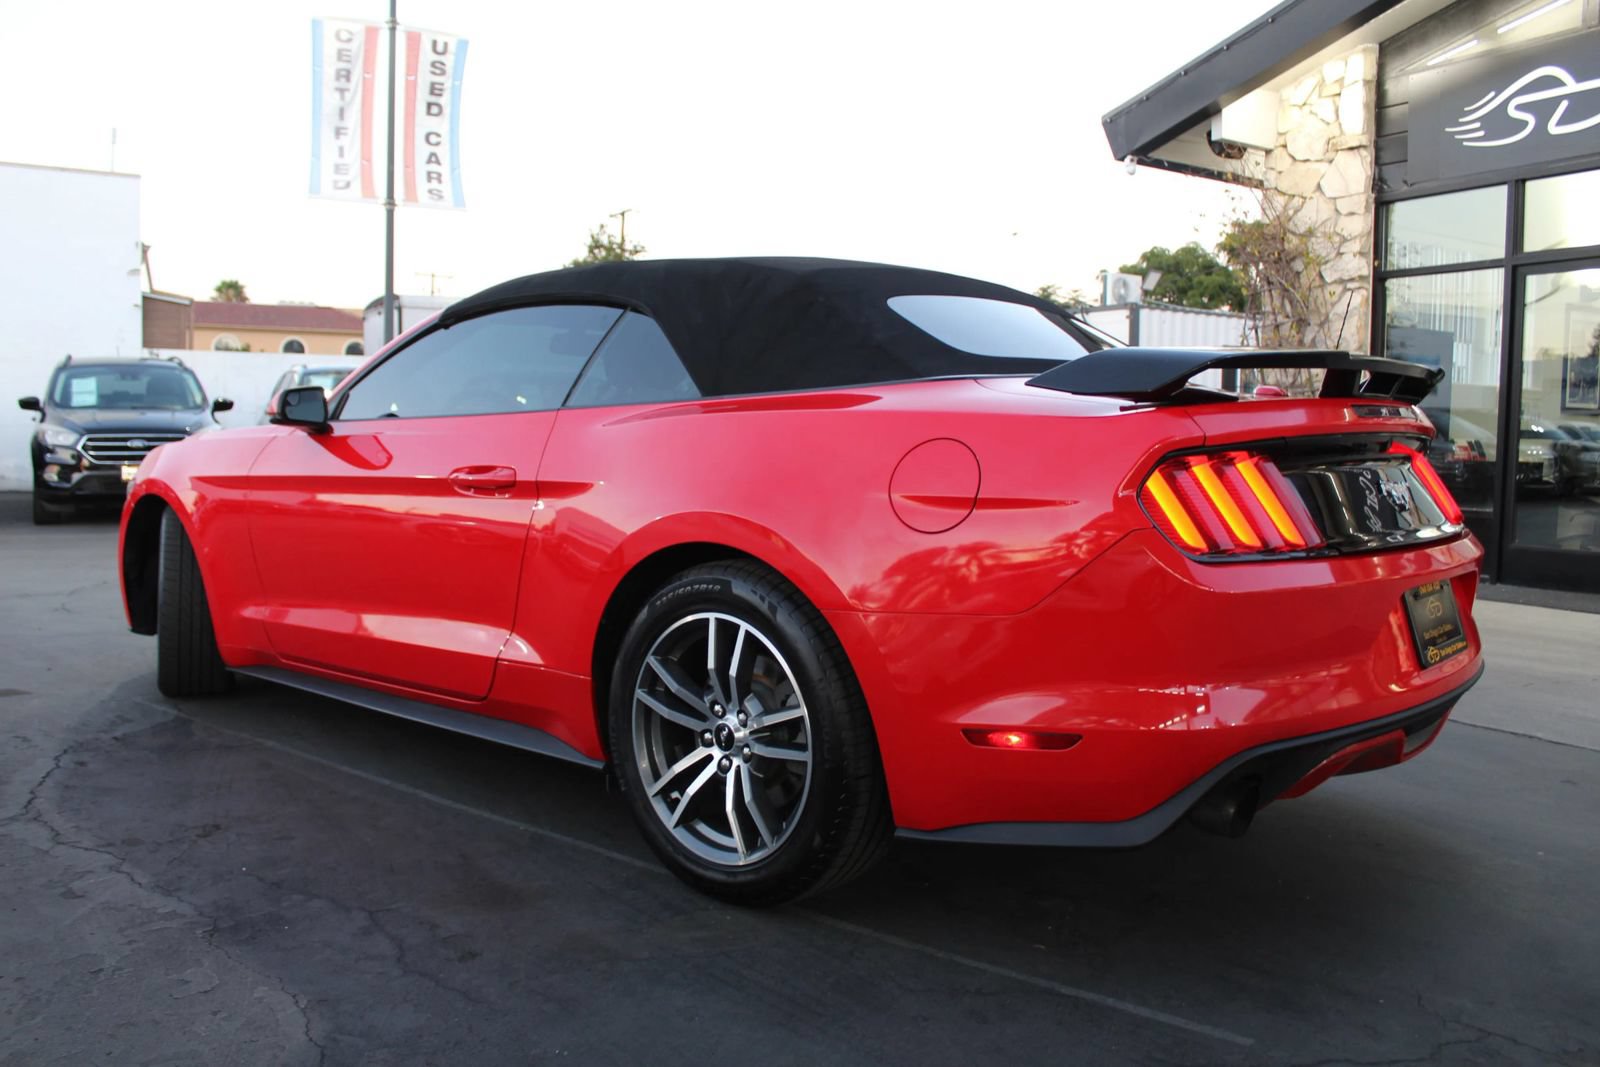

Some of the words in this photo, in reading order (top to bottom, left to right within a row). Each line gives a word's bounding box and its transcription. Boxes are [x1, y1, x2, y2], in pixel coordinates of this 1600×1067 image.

[332, 28, 354, 191] CERTIFIED
[425, 39, 449, 118] USED
[424, 131, 445, 201] CARS
